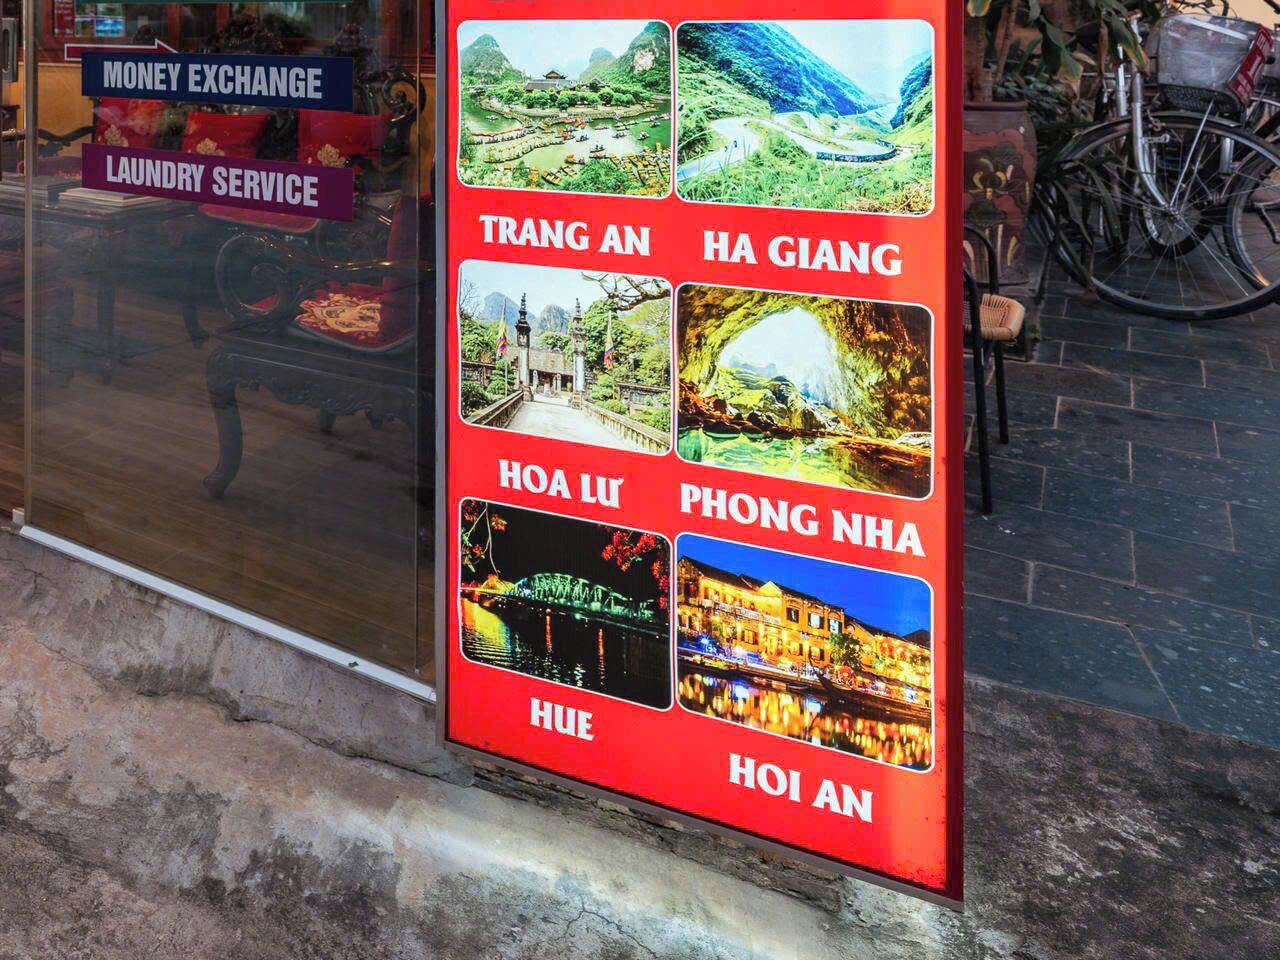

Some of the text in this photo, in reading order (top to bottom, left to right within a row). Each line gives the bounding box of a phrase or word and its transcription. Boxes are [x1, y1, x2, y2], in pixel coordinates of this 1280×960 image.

[103, 60, 323, 100] MONEY EXCHANGE
[106, 154, 319, 207] LAUNDRY SERVICE
[479, 214, 651, 257] TRANG AN
[703, 230, 903, 276] HA GIANG
[498, 459, 625, 510] HOA LƯ
[680, 482, 926, 558] PHONG NHA
[529, 698, 595, 742] HUE
[728, 753, 873, 824] HOI AN
